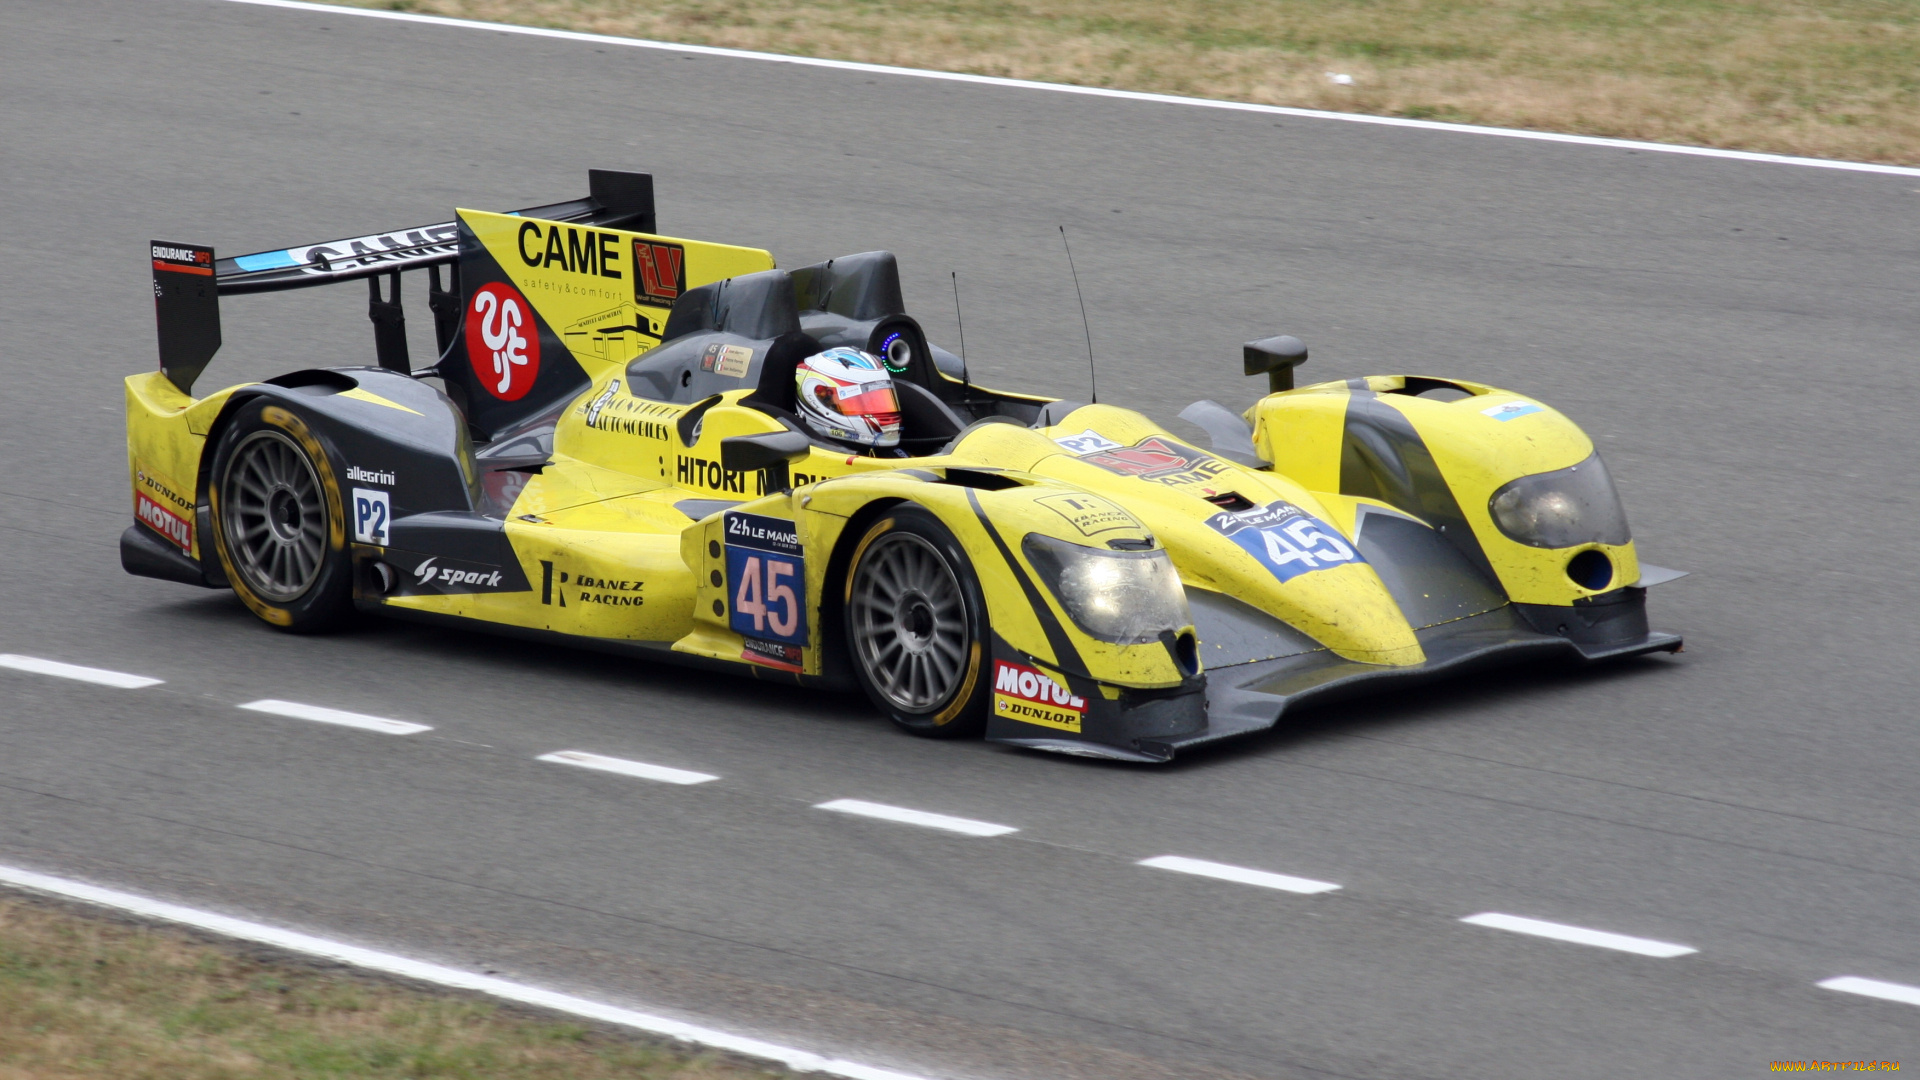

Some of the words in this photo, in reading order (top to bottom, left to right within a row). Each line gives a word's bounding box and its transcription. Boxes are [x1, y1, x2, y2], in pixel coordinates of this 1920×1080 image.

[518, 221, 622, 279] CAME
[596, 415, 669, 441] AUTOMOBILES
[1059, 435, 1109, 451] P2
[346, 466, 395, 485] allegrini
[677, 455, 745, 494] HITORI
[1138, 461, 1232, 486] AME
[145, 476, 195, 511] DUNLOP
[139, 496, 190, 546] MOTUL
[357, 497, 386, 538] P2
[1081, 516, 1129, 527] RACING
[752, 527, 765, 539] LE
[766, 529, 798, 544] MANS
[1260, 519, 1354, 567] 45
[438, 568, 502, 587] spark
[576, 574, 644, 592] IBANEZ
[580, 592, 644, 606] RACING
[736, 556, 798, 637] 45
[1010, 703, 1076, 725] DUNLOP
